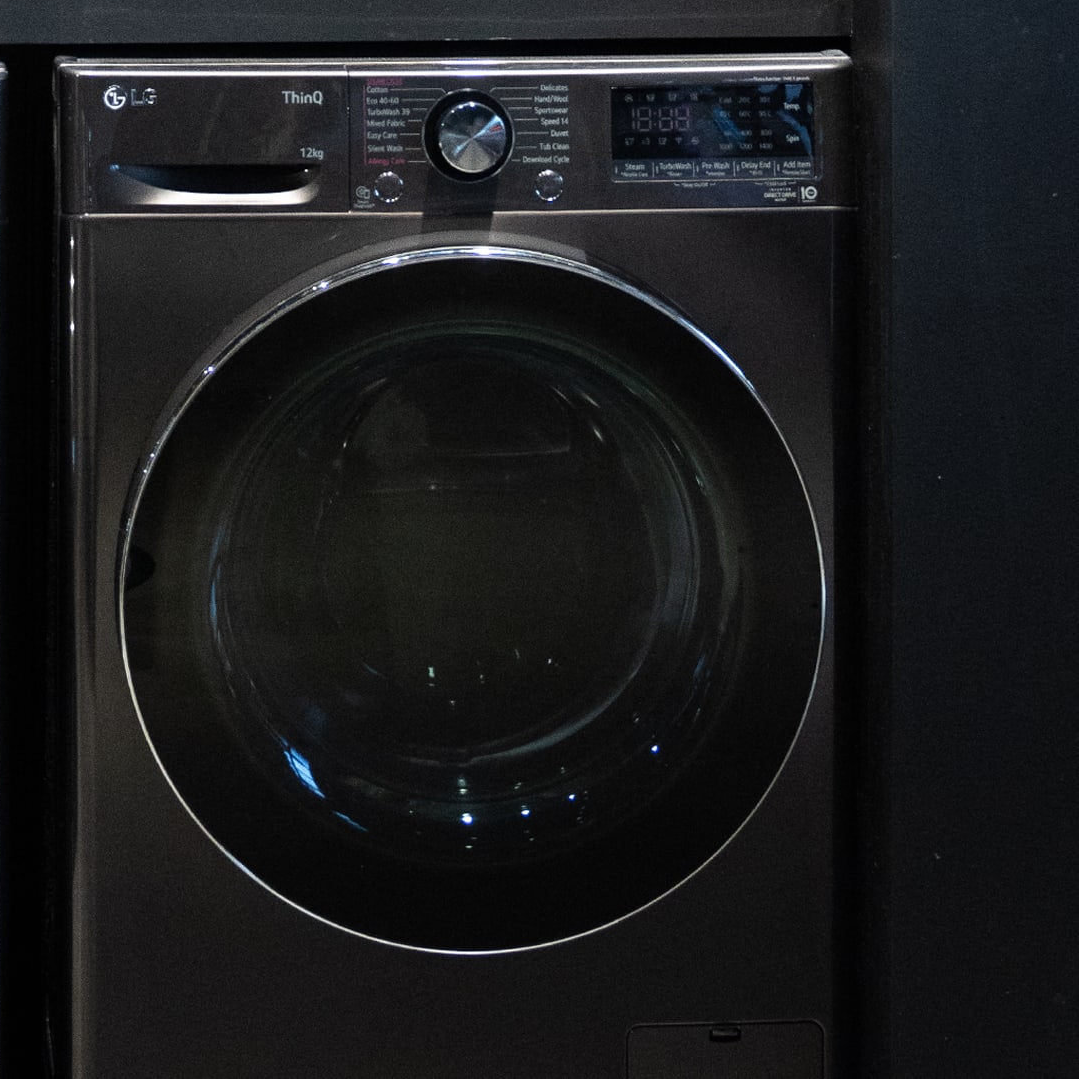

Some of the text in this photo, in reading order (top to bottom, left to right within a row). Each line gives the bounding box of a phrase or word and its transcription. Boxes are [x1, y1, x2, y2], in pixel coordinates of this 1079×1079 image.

[130, 87, 157, 106] LG
[282, 90, 324, 106] ThinQ
[534, 95, 569, 103] Hand/Wool
[534, 107, 569, 115] Sportswear
[783, 102, 801, 111] Temp.
[540, 118, 560, 127] Speed
[367, 131, 397, 141] Easy Care
[550, 129, 569, 137] Duvet
[785, 134, 800, 143] Spin
[386, 145, 403, 153] Wash
[539, 143, 570, 151] Tub Clean
[299, 147, 324, 160] 12kg
[553, 156, 570, 165] Cycle
[714, 161, 730, 169] Wash
[783, 161, 811, 169] Add Item
[659, 162, 692, 170] TurboWash
[741, 161, 771, 170] Delay End
[800, 185, 818, 200] 10
